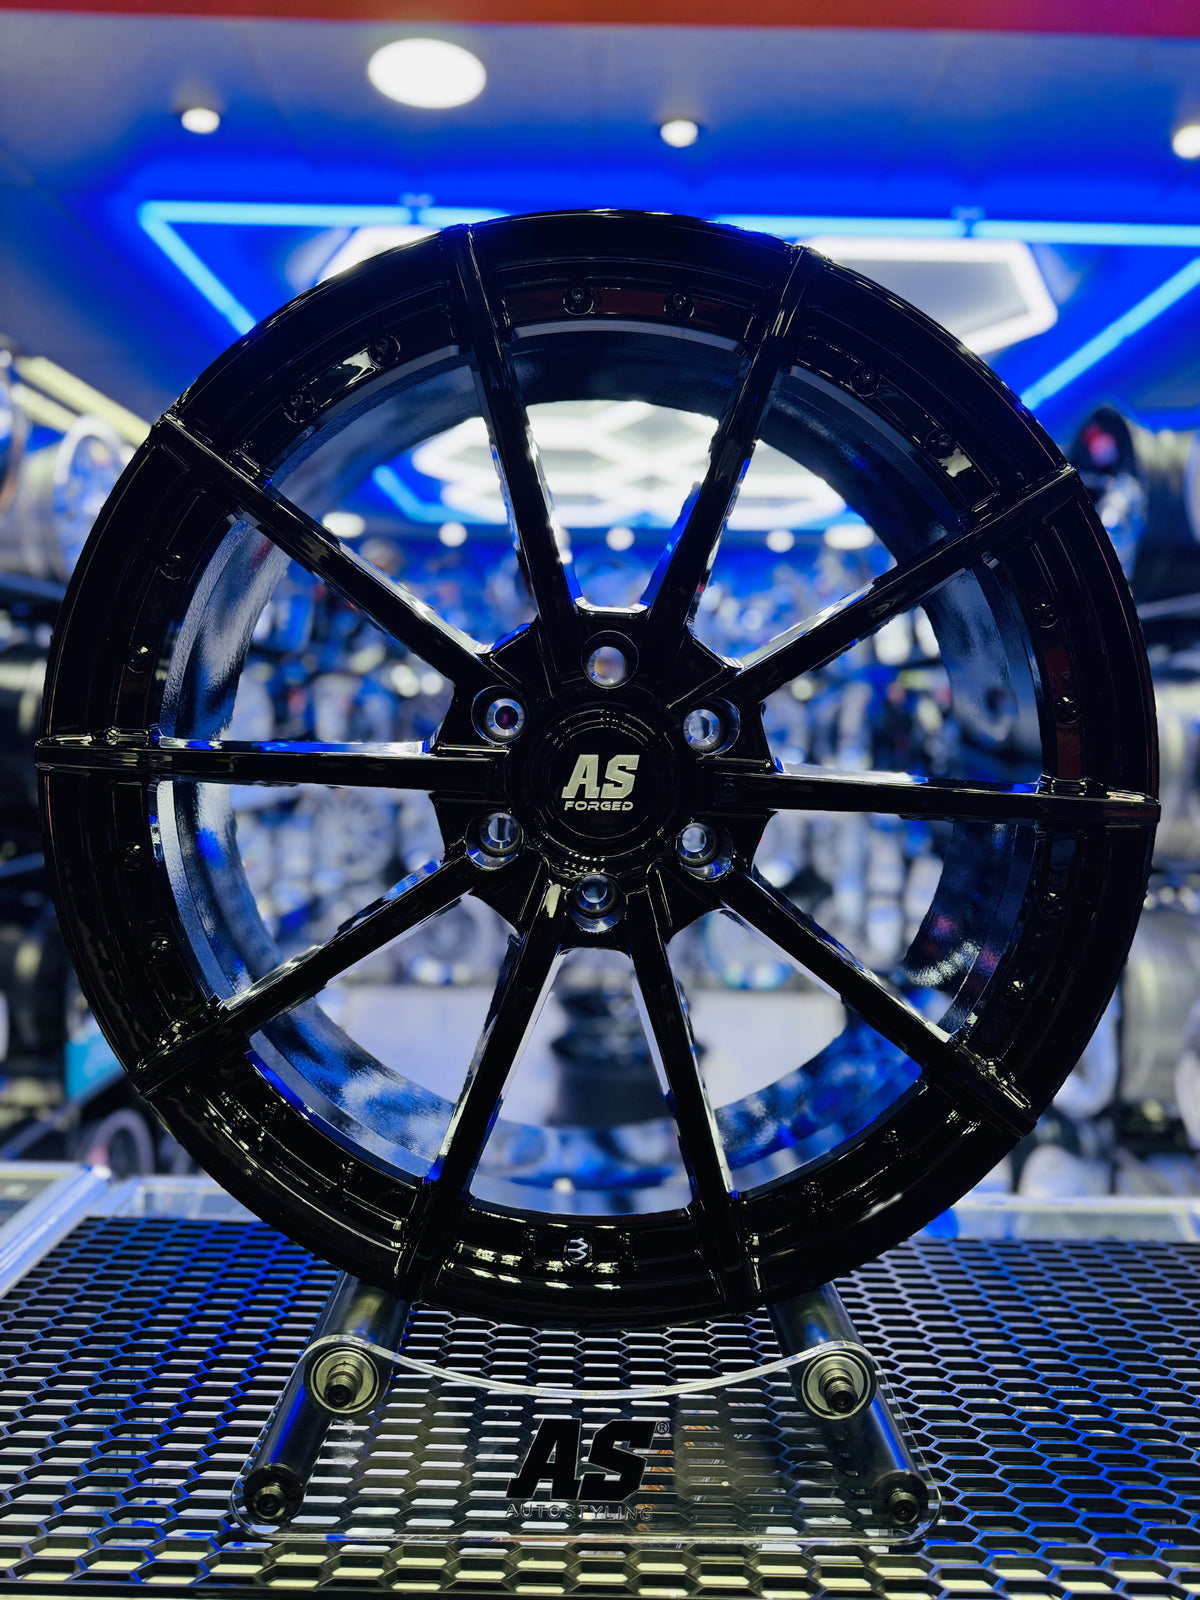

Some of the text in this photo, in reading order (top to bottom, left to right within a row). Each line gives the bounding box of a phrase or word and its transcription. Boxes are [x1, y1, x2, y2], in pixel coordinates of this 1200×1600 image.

[561, 754, 640, 799] AS
[564, 800, 634, 811] FORGED
[506, 1503, 653, 1521] AUTOSTYLING
